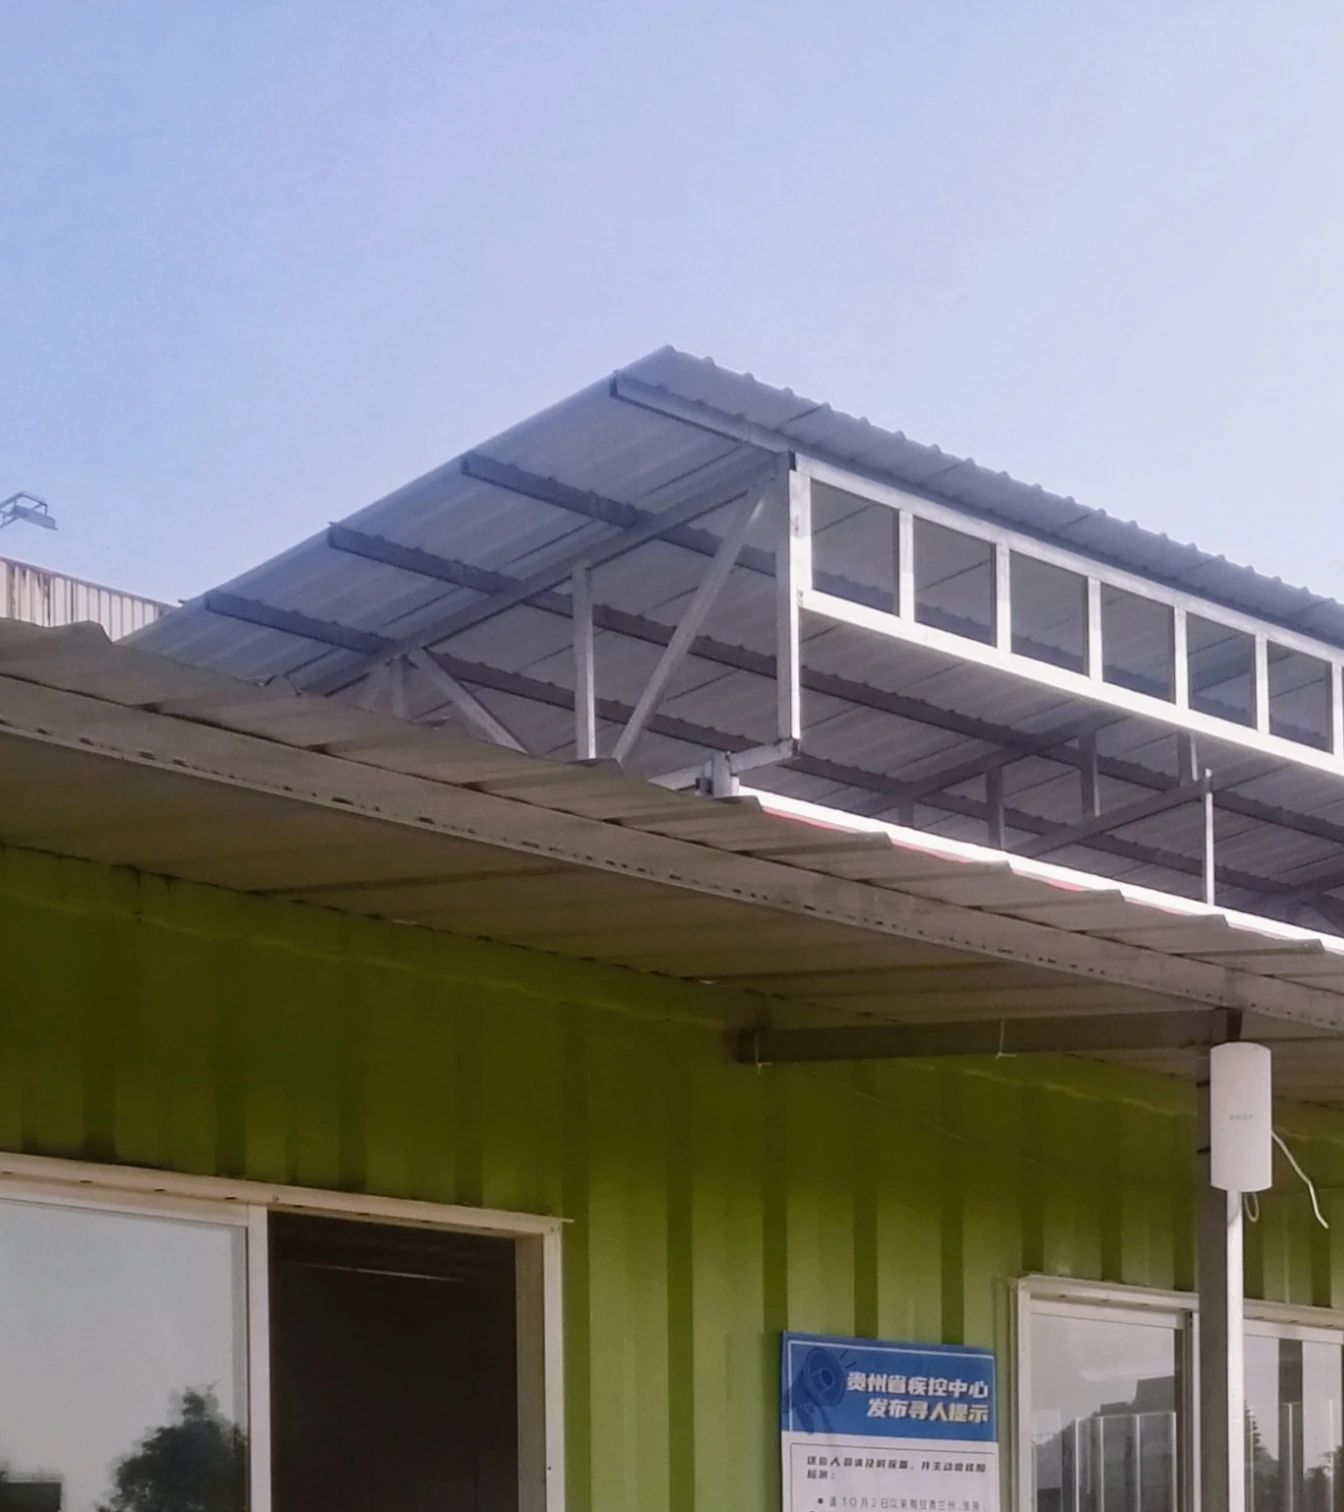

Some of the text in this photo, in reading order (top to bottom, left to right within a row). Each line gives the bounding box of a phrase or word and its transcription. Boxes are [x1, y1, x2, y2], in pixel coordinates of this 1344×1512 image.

[846, 1370, 989, 1399] 贵州省疾控中心
[866, 1397, 989, 1424] 发布寻人提示
